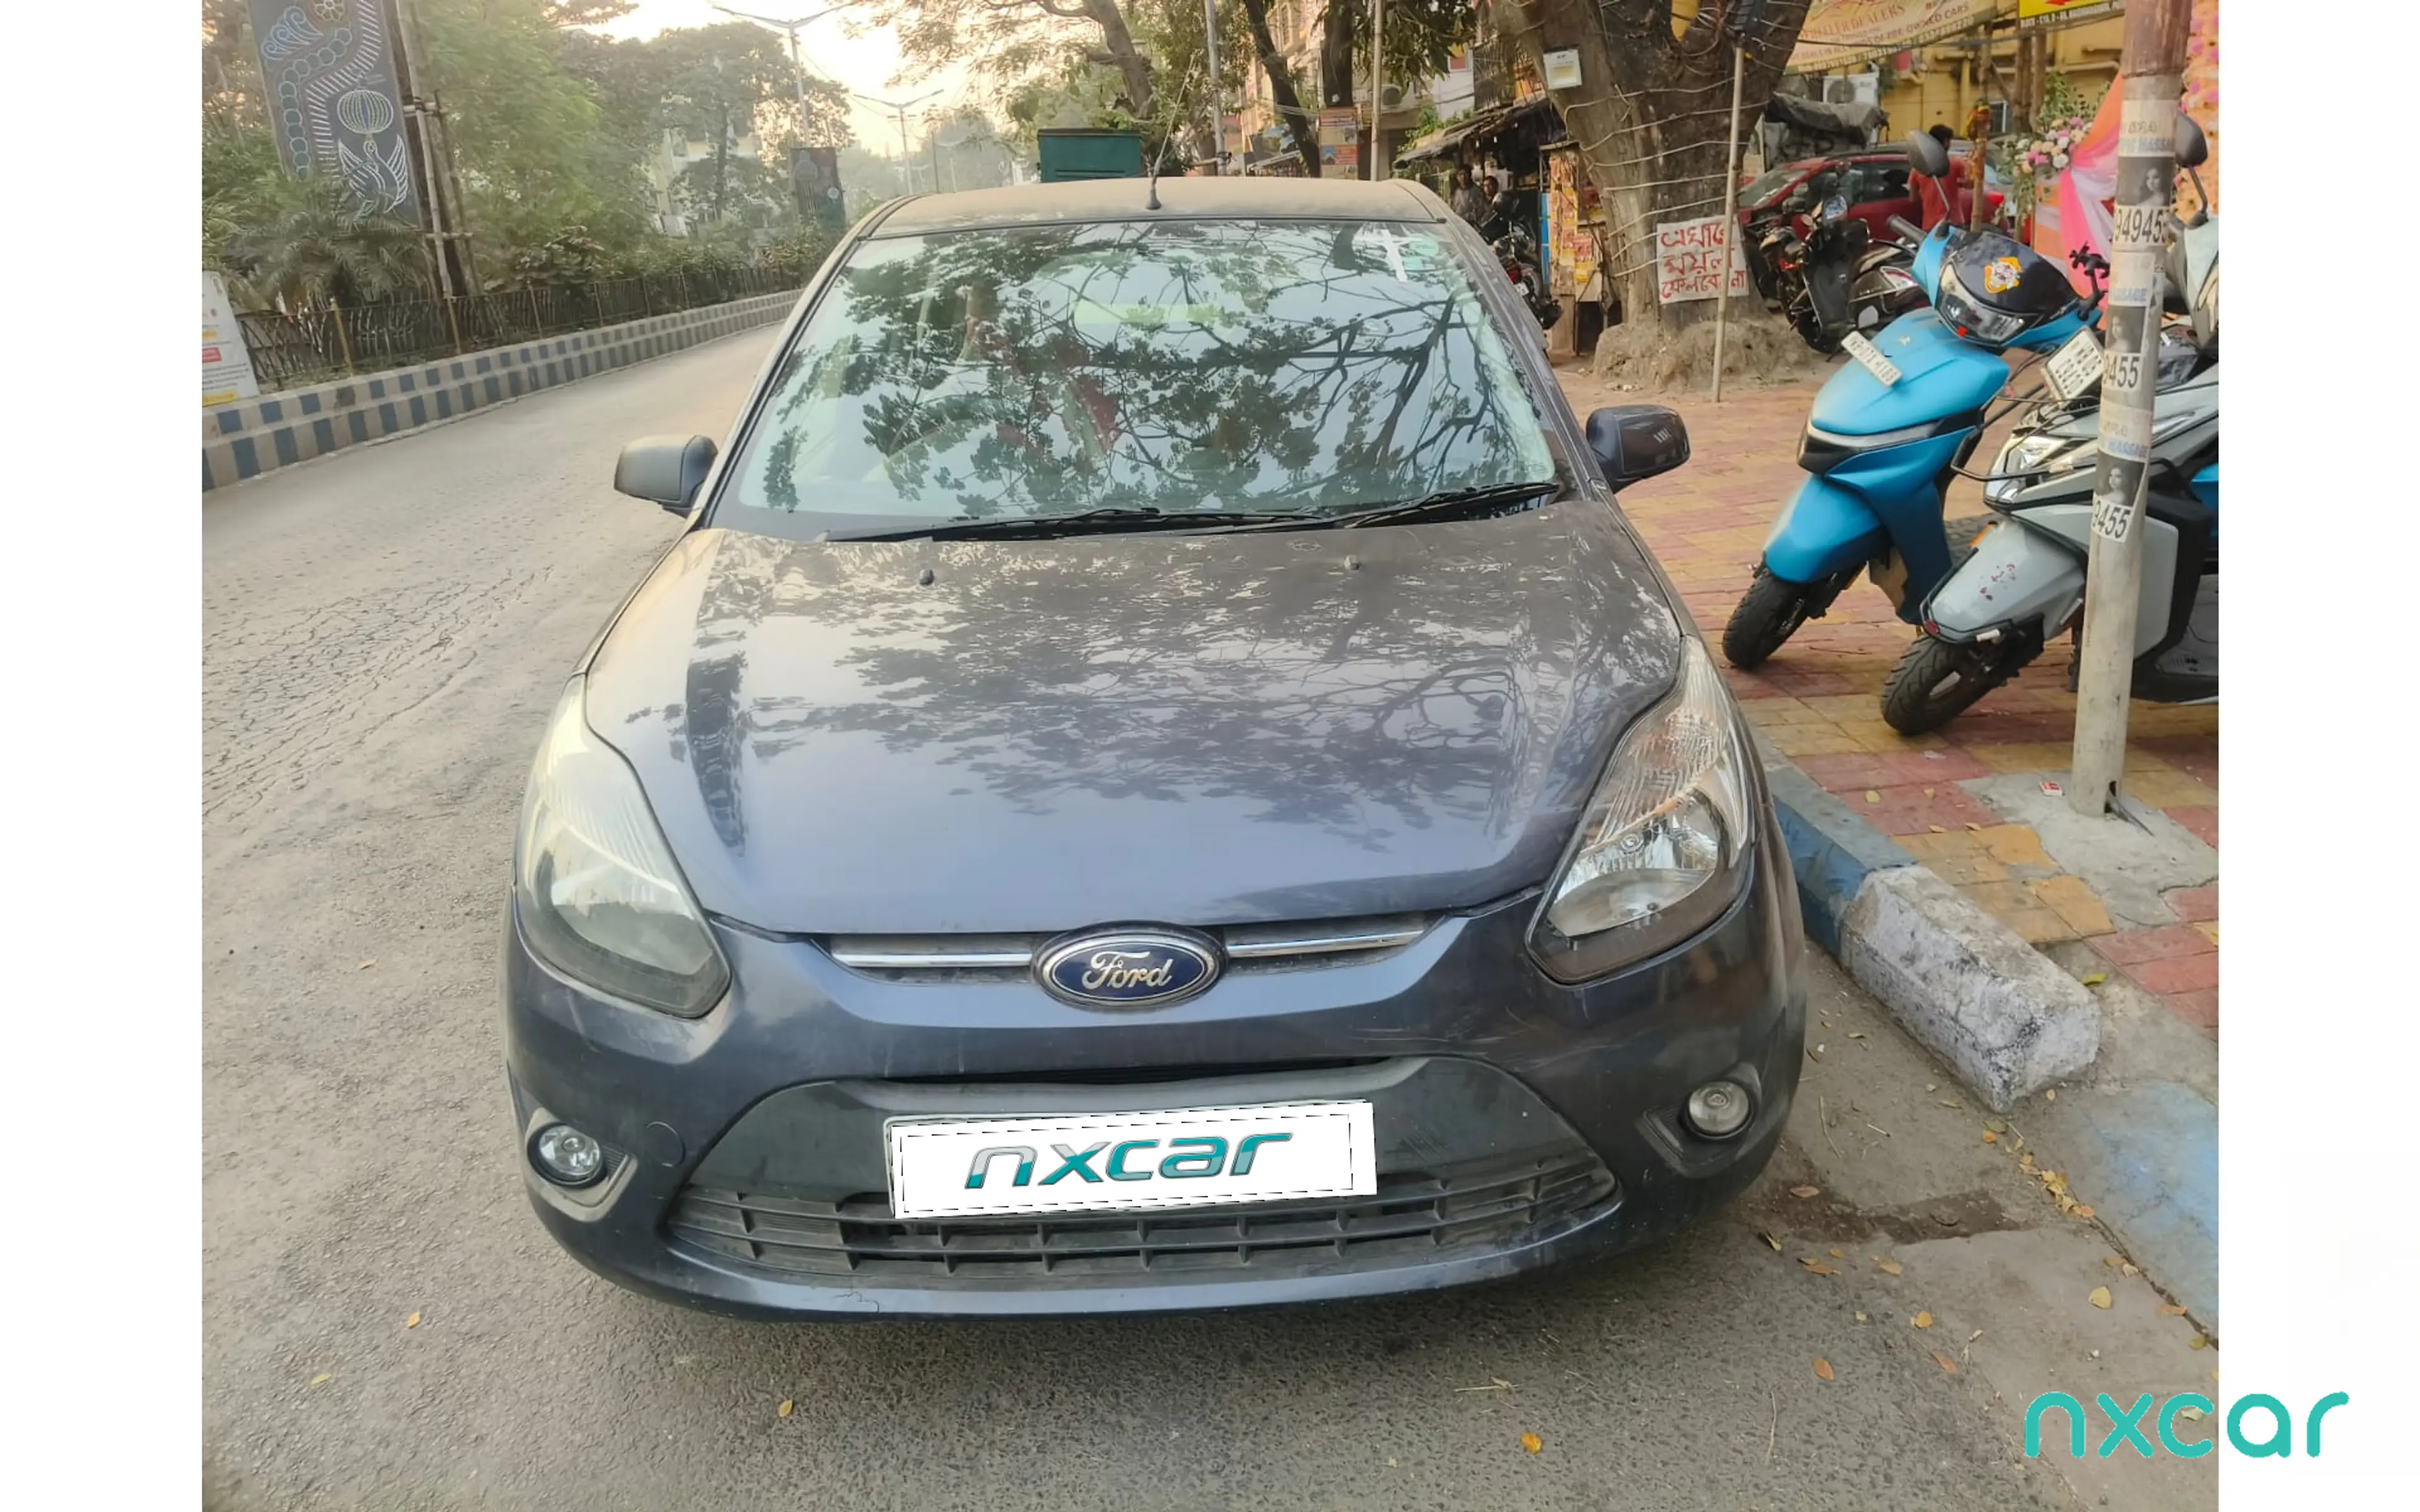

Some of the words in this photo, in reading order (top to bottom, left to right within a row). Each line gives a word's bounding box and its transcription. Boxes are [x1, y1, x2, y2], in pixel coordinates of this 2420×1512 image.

[1944, 4, 1969, 18] CARS
[1731, 270, 1745, 289] না
[1081, 950, 1172, 990] Ford
